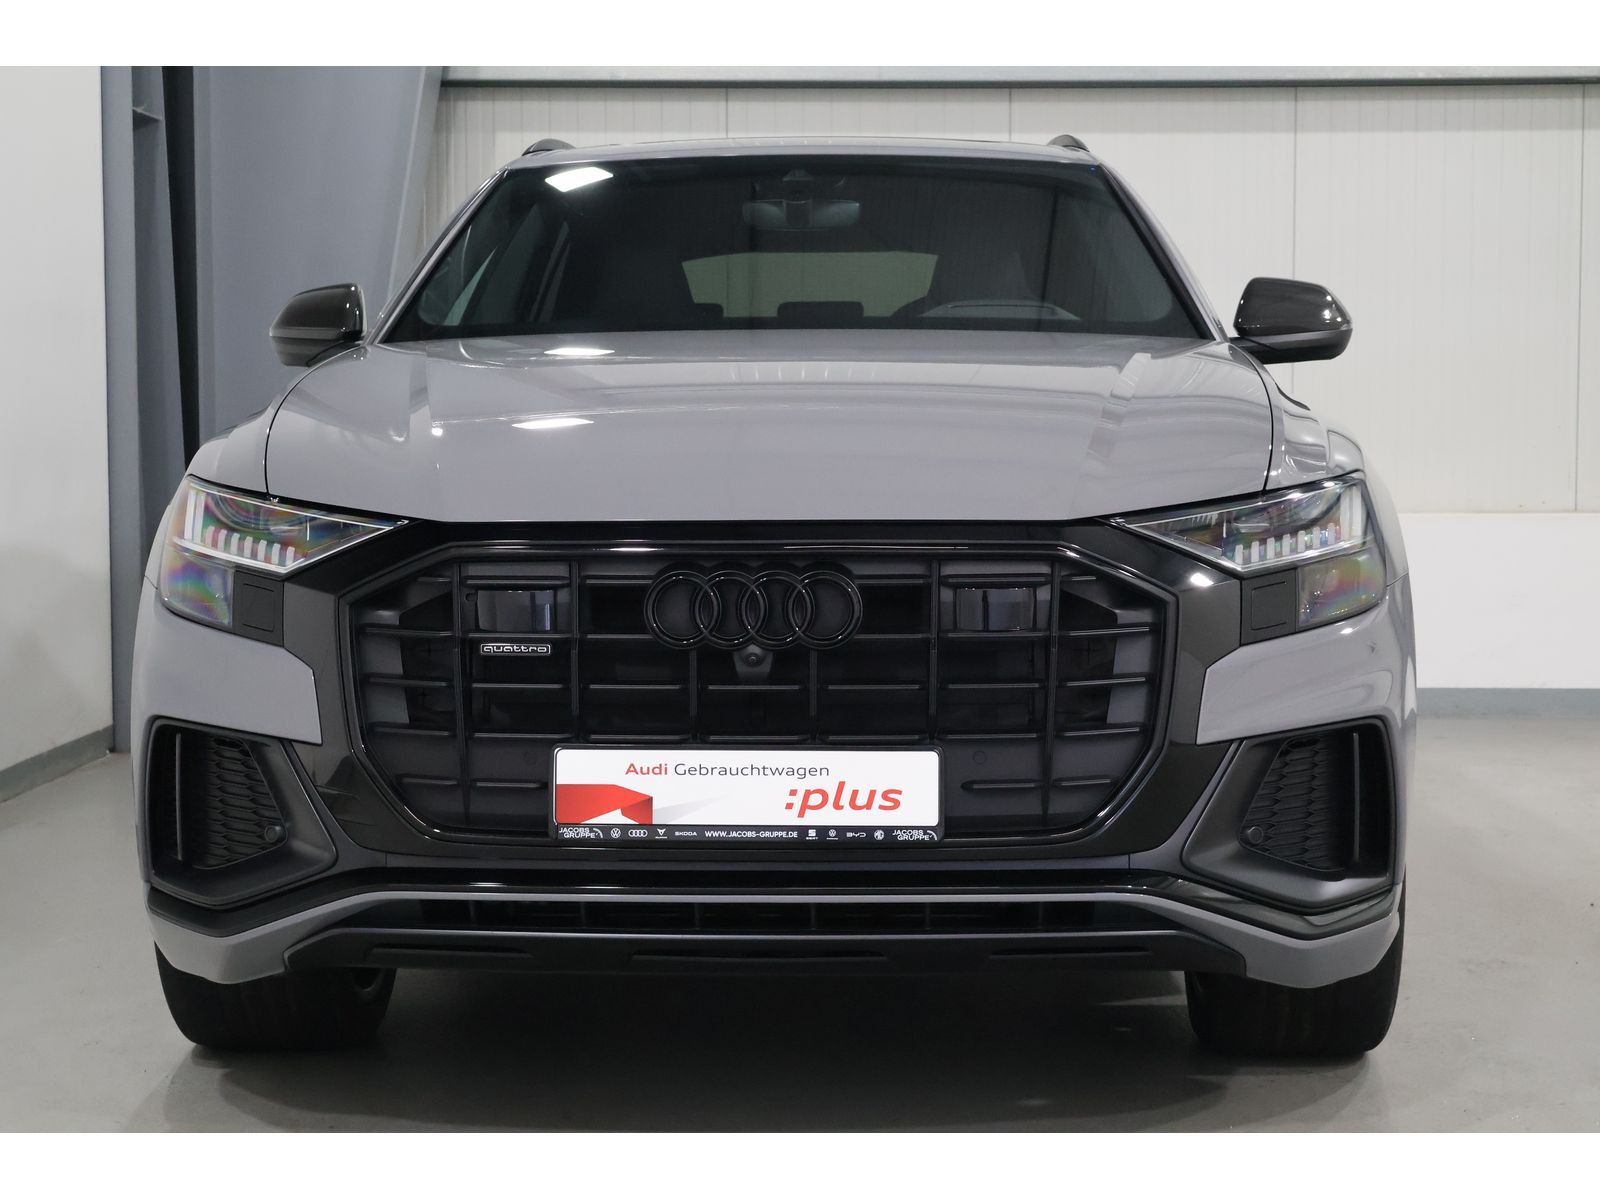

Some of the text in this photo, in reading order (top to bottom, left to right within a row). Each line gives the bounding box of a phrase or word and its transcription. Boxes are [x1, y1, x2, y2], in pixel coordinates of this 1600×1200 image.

[483, 645, 547, 653] quattro
[625, 763, 830, 780] Audi Gebrauchtwagen
